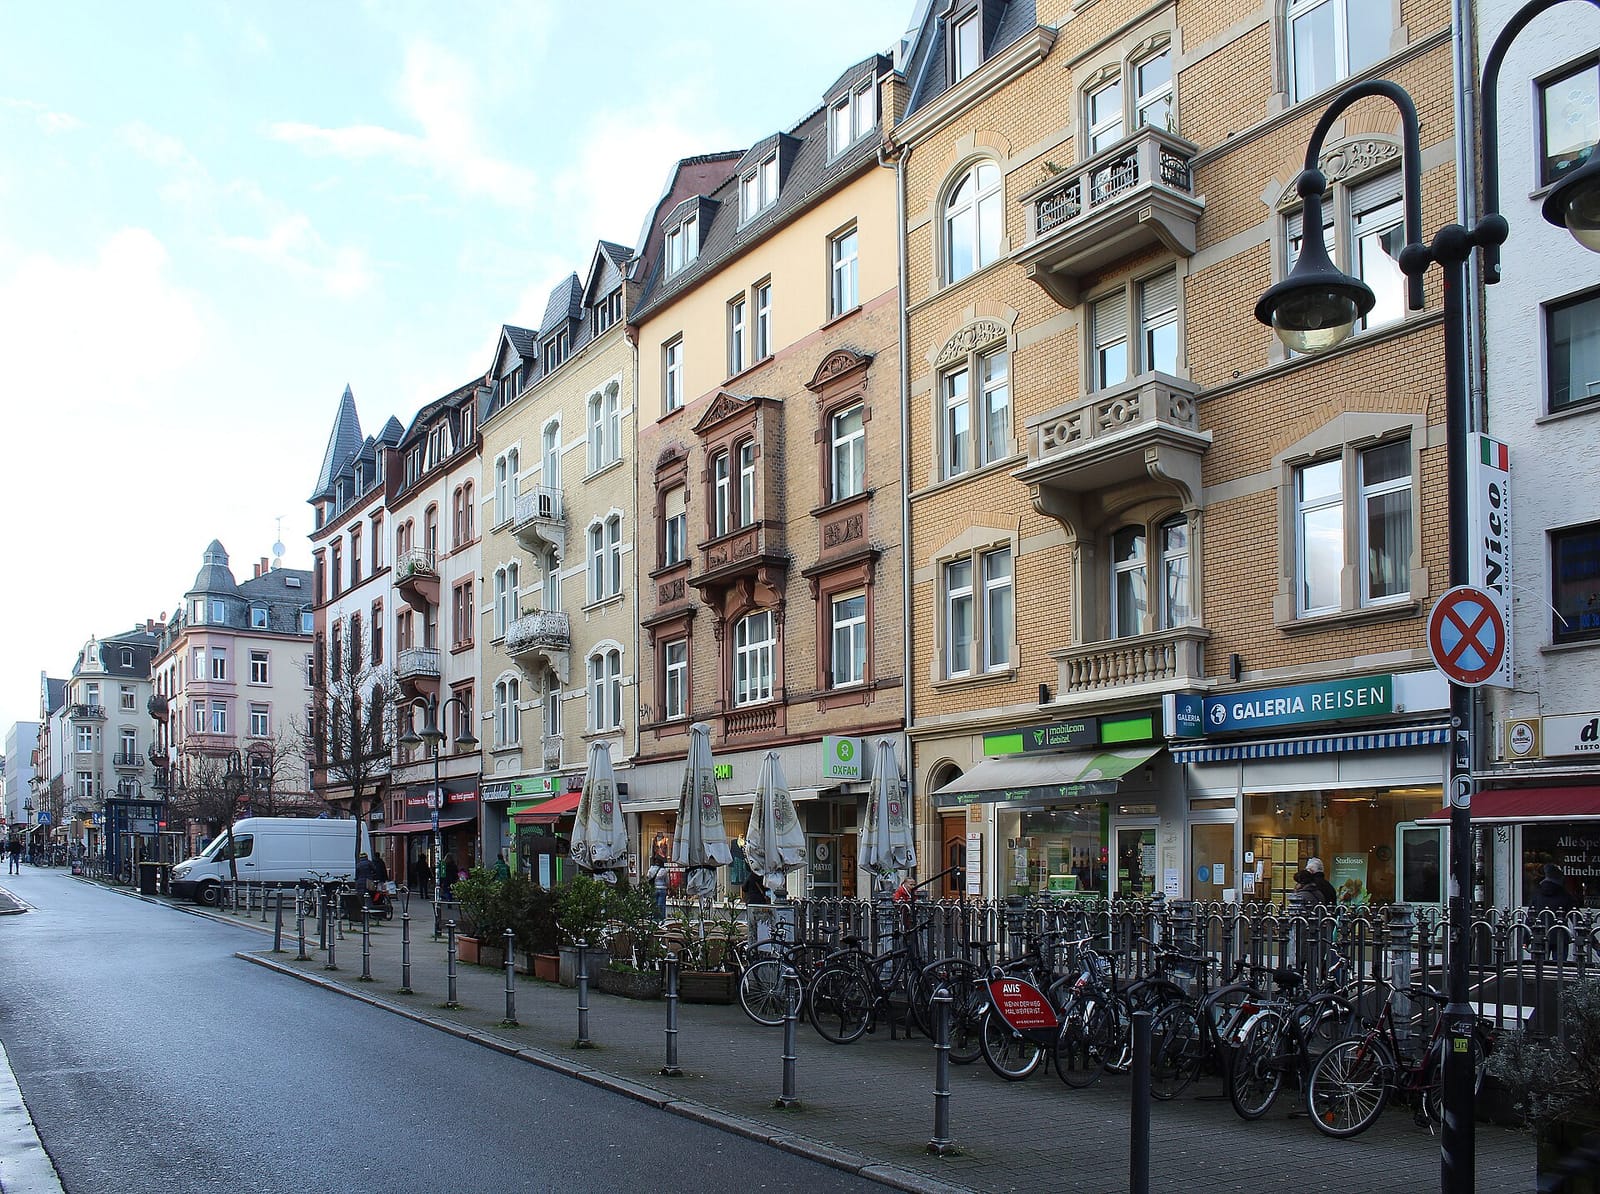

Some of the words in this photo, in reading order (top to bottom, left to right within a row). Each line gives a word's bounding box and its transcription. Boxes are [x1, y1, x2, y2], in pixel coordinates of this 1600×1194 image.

[1485, 483, 1502, 596] Nico
[1232, 696, 1305, 720] GALERIA
[1311, 686, 1385, 711] REISEN
[1177, 713, 1201, 722] GALERIA
[832, 764, 859, 776] OXFAM
[1556, 836, 1577, 847] Alle
[1335, 856, 1364, 865] Studiosus
[1003, 984, 1020, 993] AVIS
